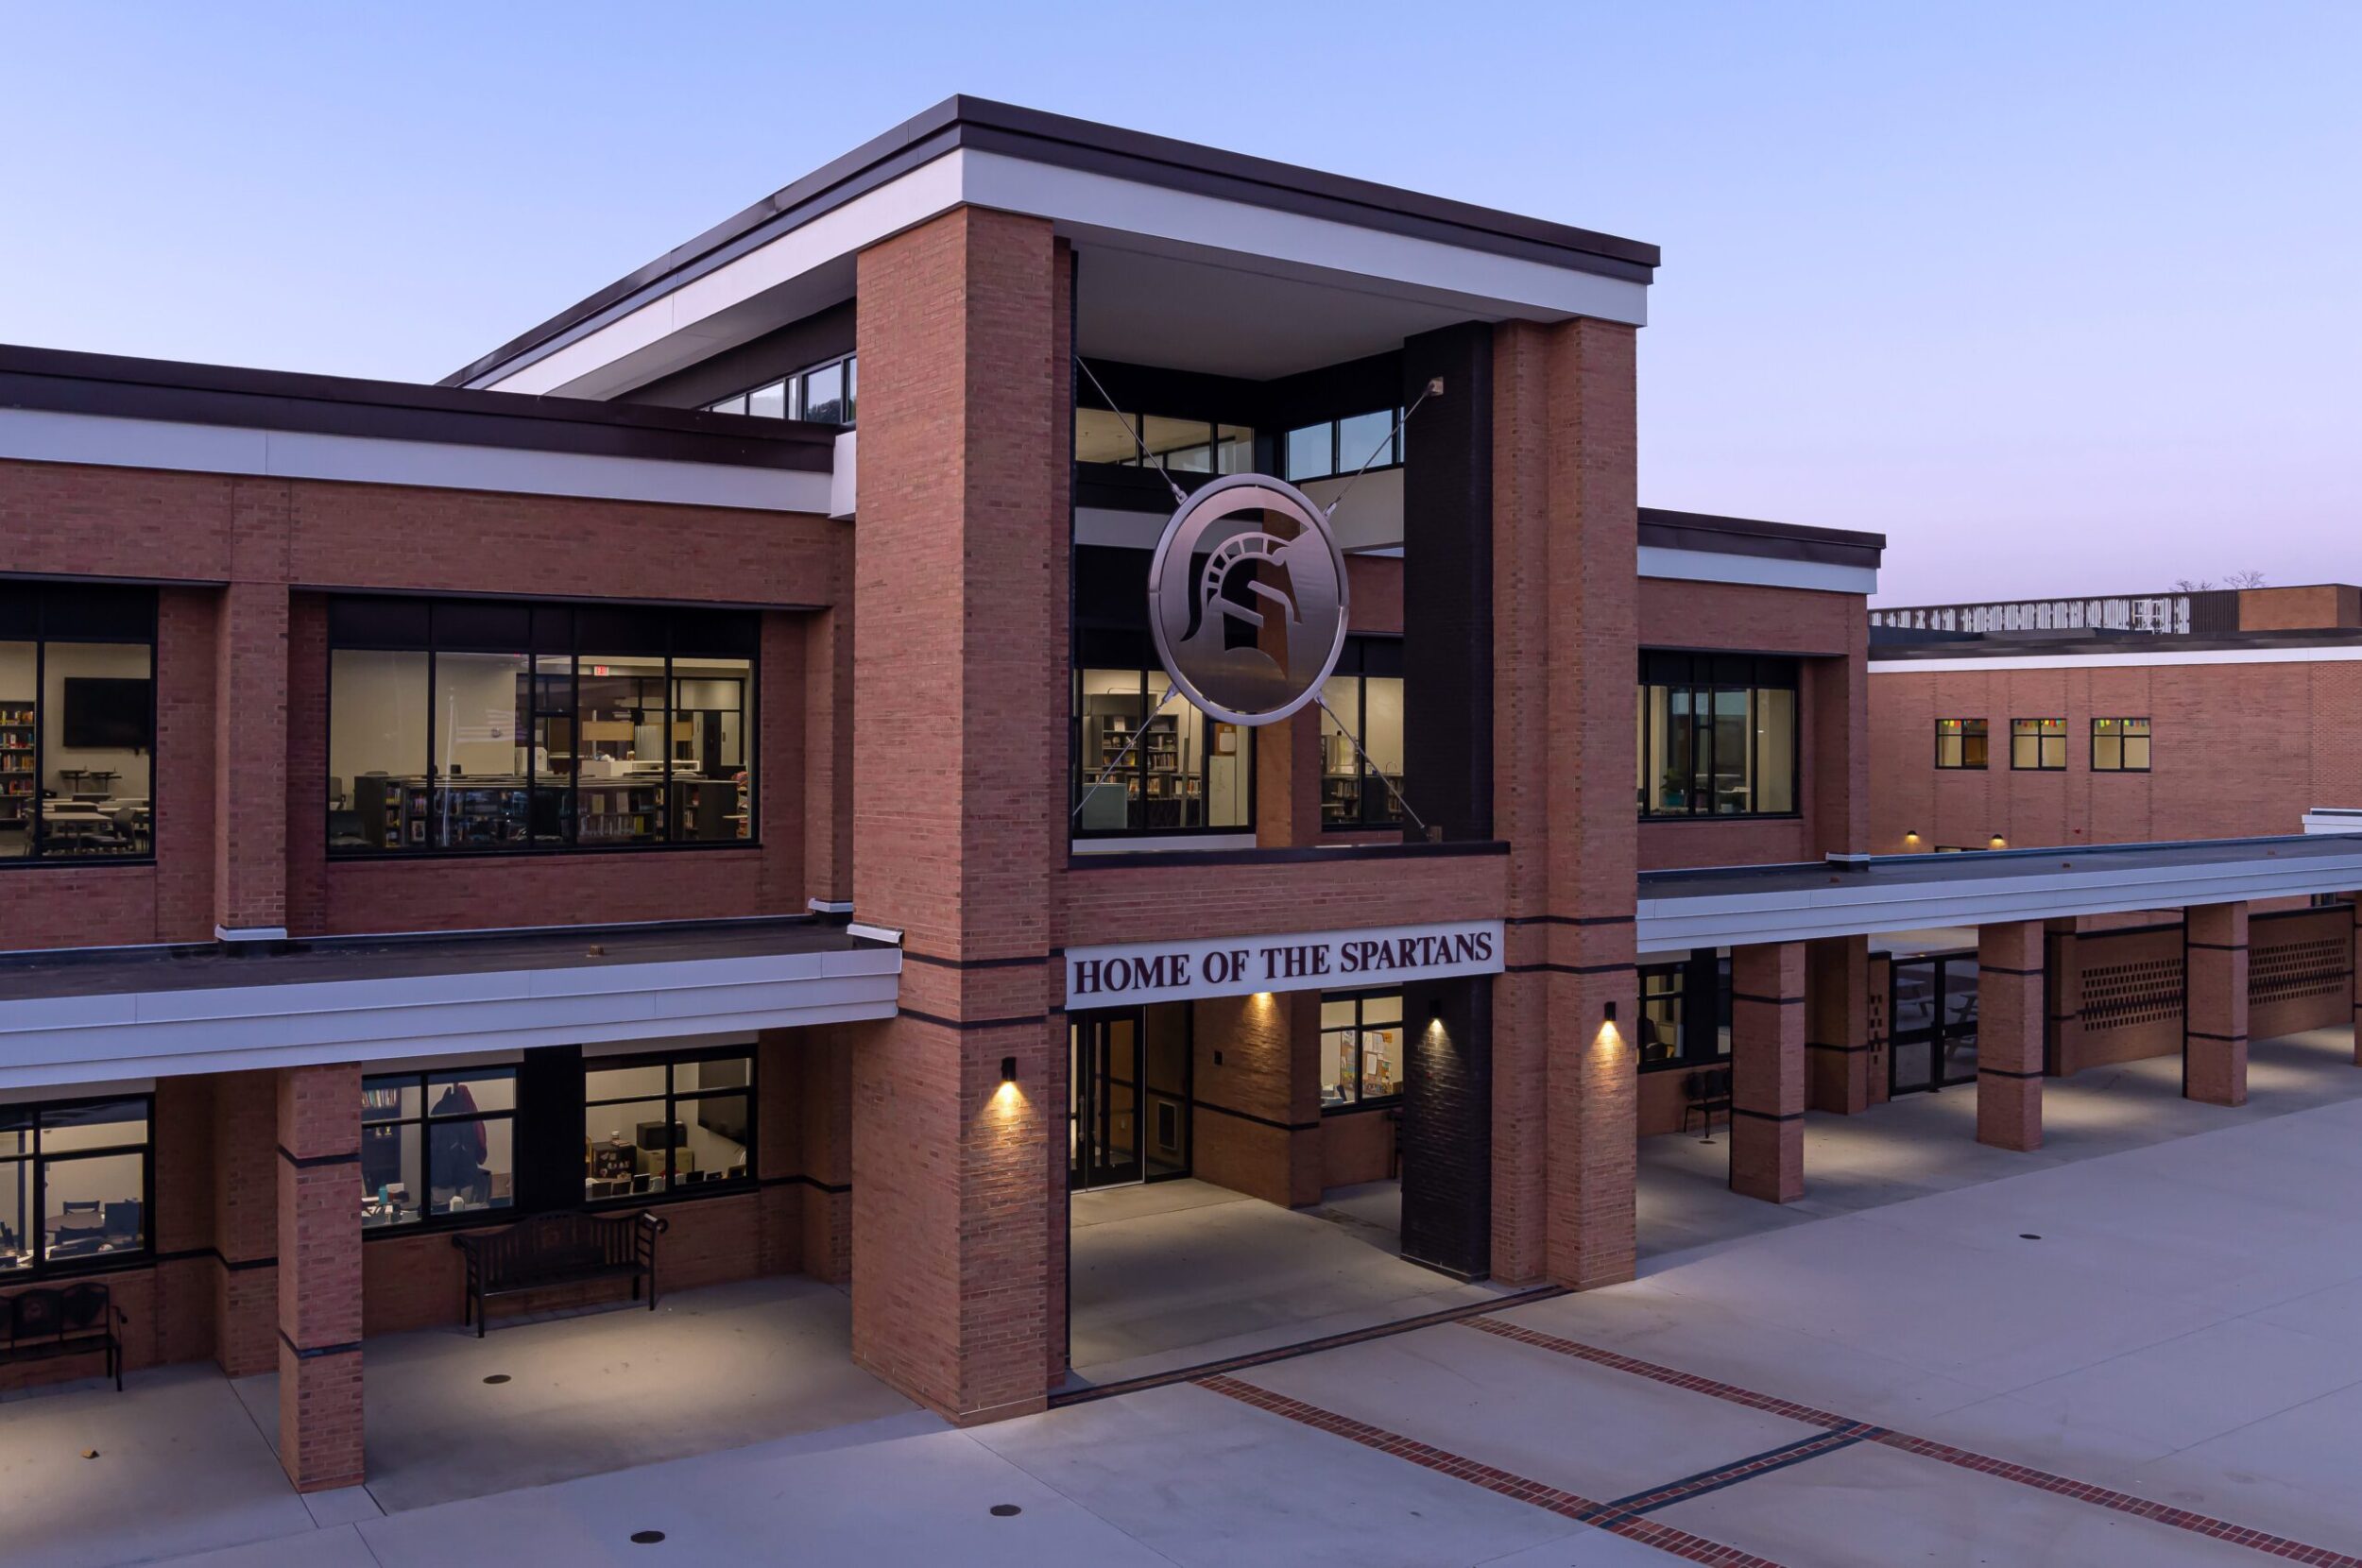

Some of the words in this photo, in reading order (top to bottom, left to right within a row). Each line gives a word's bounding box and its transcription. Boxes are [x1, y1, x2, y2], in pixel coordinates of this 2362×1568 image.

[1073, 954, 1190, 995] HOME
[1202, 949, 1249, 984] OF
[1260, 945, 1330, 980] THE
[1340, 931, 1493, 973] SPARTANS
